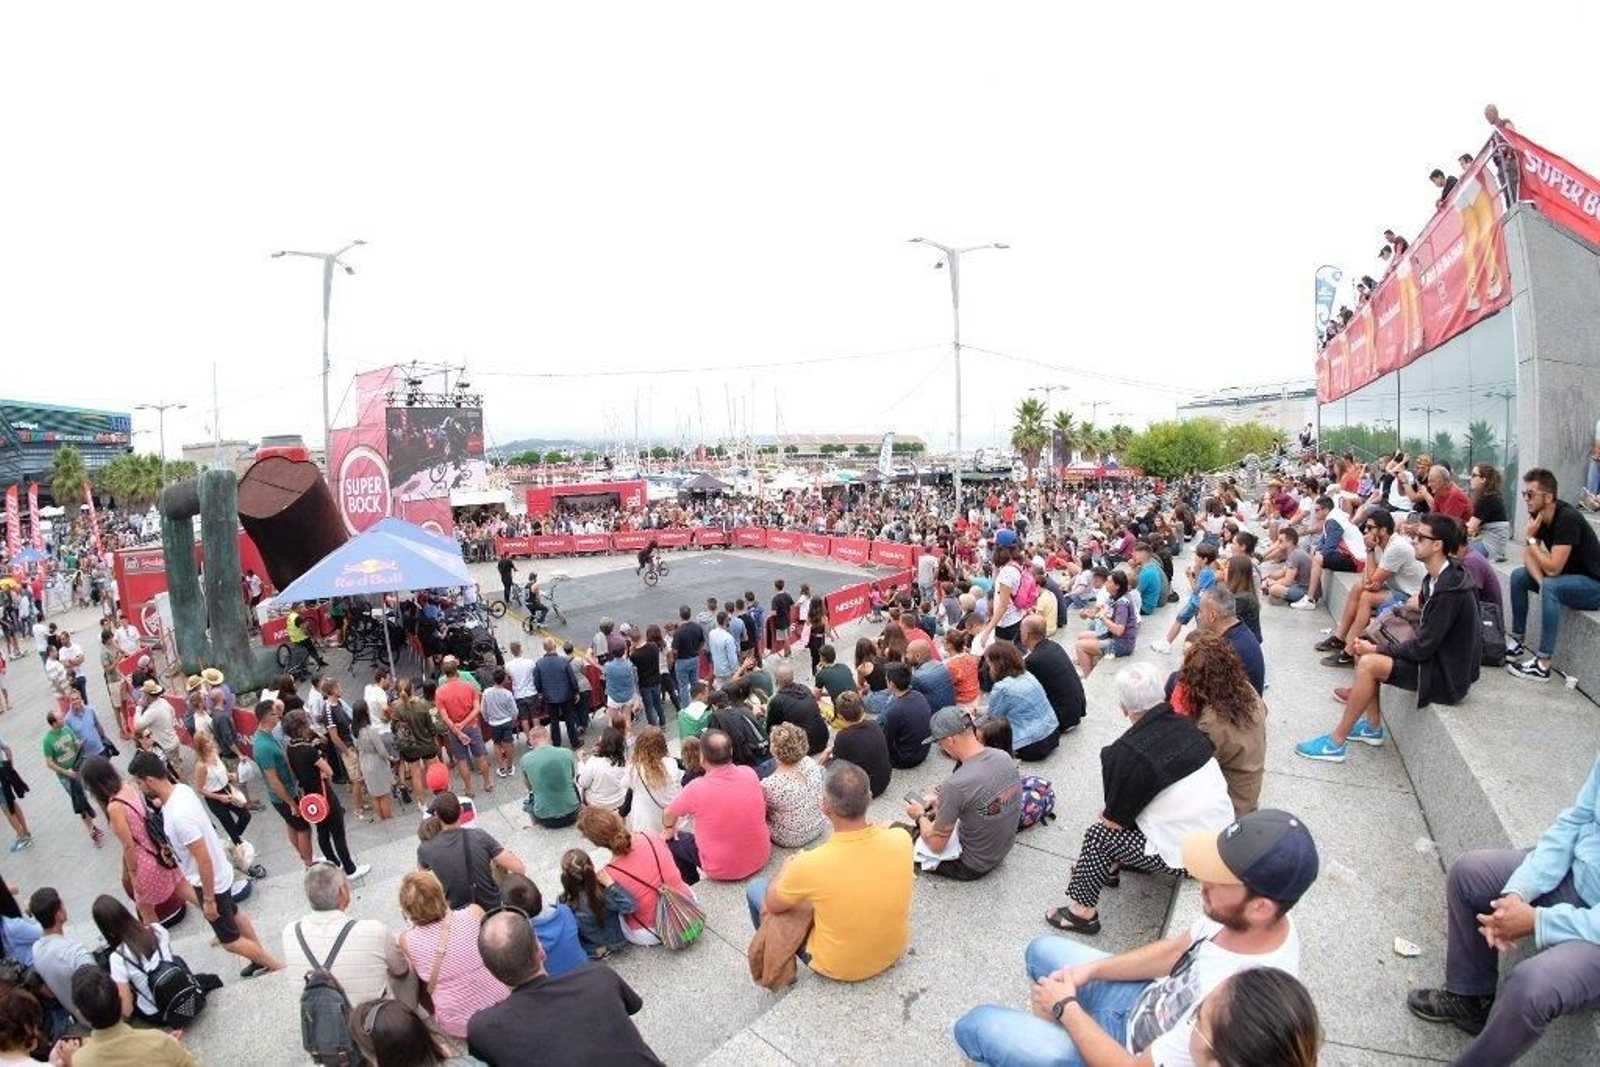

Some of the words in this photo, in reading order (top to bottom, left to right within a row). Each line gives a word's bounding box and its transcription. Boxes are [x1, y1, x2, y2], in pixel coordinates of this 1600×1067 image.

[1523, 149, 1585, 207] SUPER
[346, 476, 382, 495] SUPER
[348, 495, 382, 513] BOCK
[335, 574, 368, 588] Red
[369, 570, 402, 585] Bull
[835, 596, 865, 613] NISSAN
